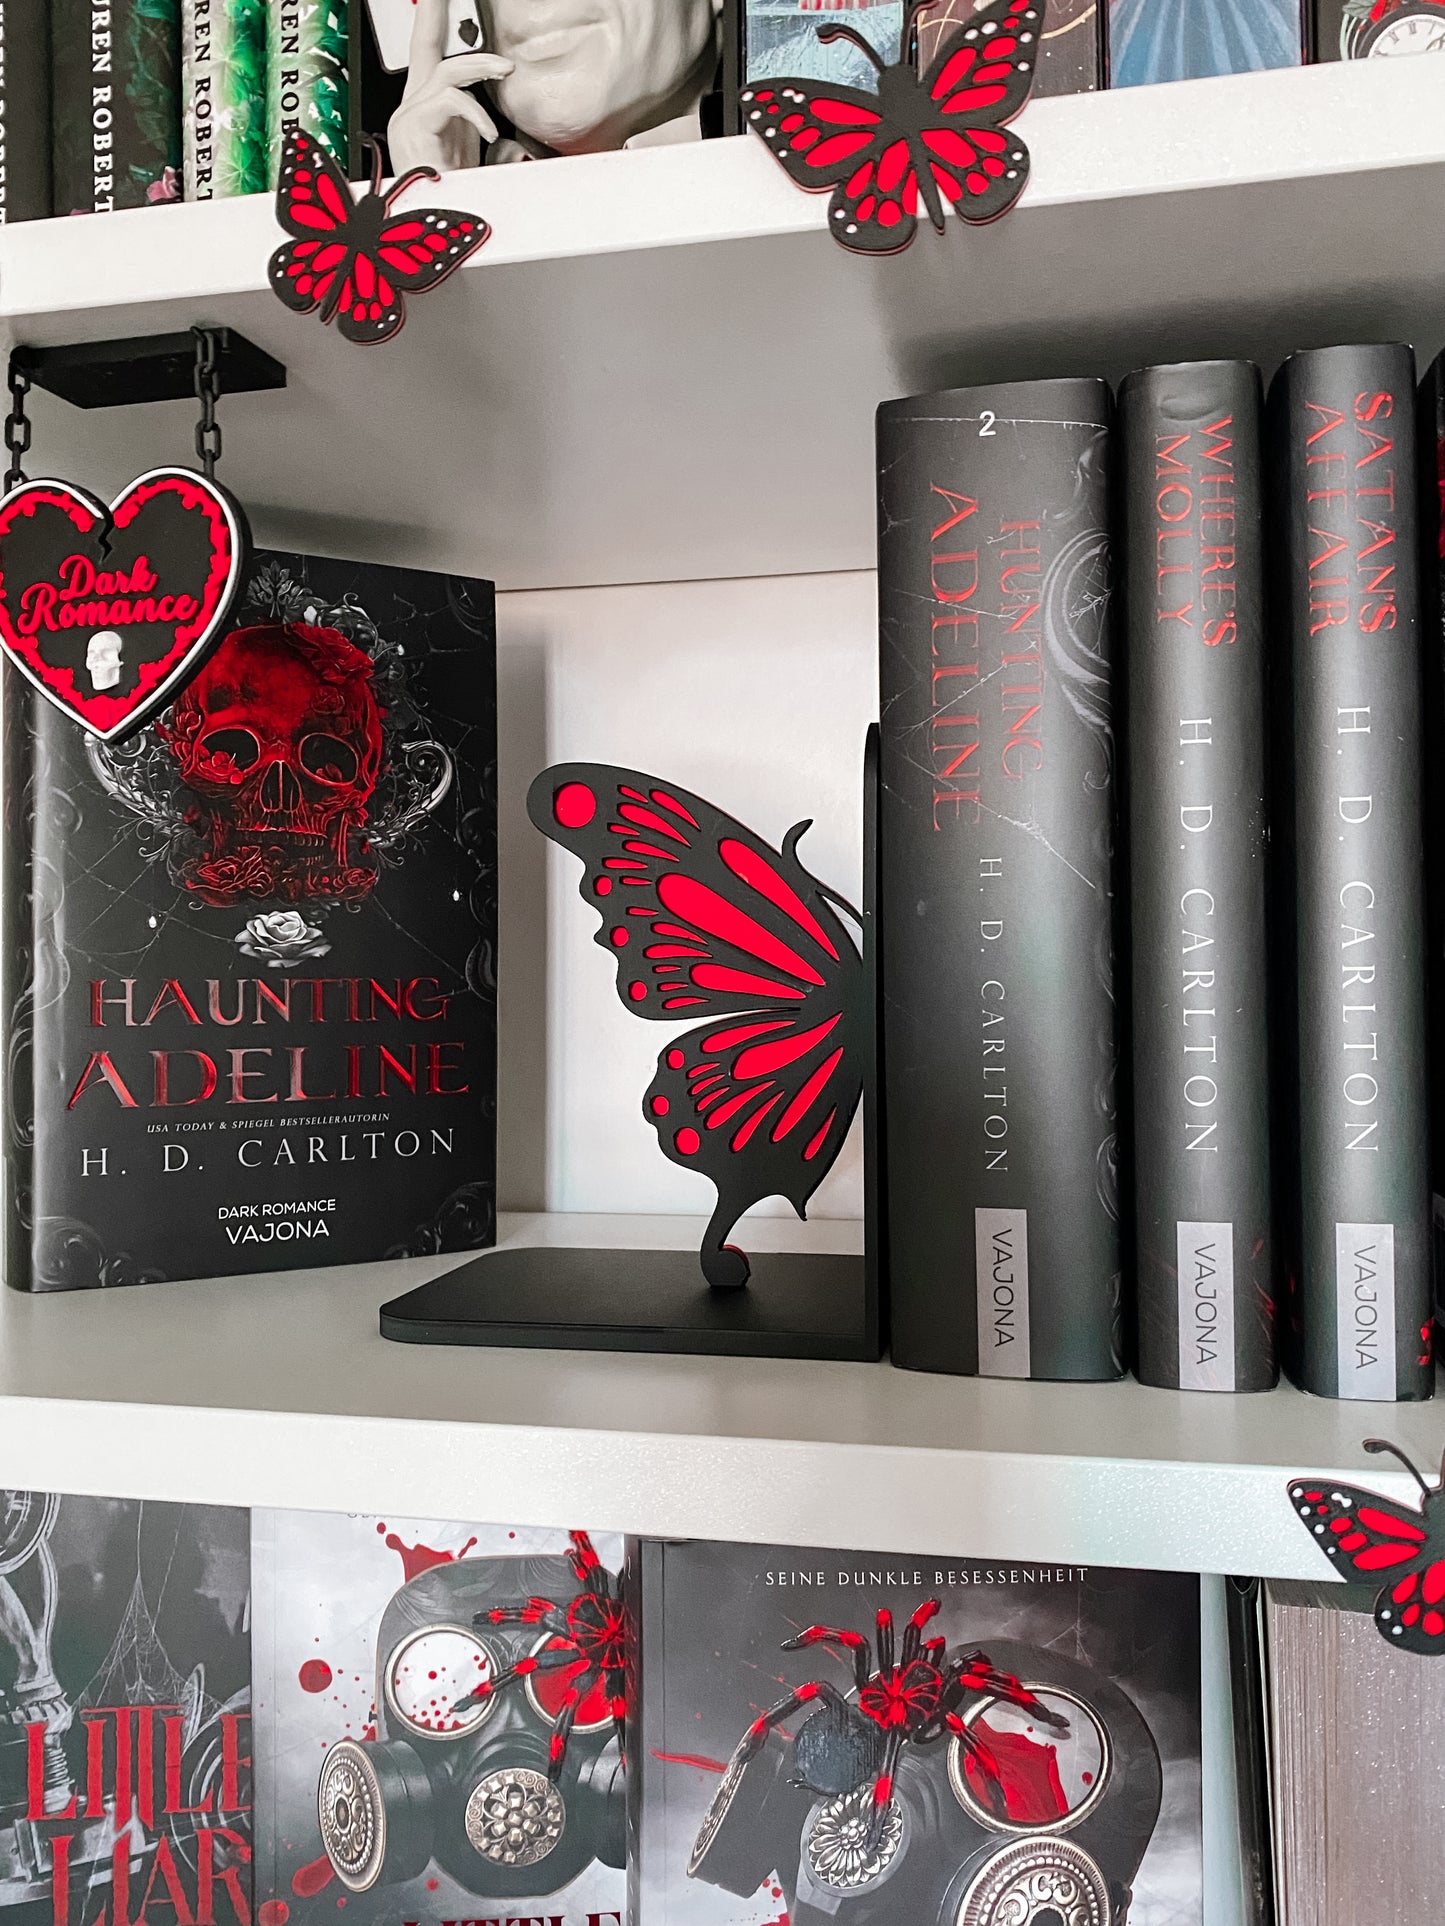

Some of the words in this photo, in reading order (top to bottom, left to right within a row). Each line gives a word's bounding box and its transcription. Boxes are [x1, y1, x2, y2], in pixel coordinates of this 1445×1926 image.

[91, 0, 112, 72] REN
[92, 85, 114, 213] ROBERT
[195, 76, 213, 200] ROBERT
[978, 411, 997, 437] 2
[1155, 433, 1194, 627] MOLLY
[1199, 414, 1237, 647] WHERE'S
[1305, 401, 1350, 637] AFFAIR
[1354, 391, 1398, 633] SATAN'S
[18, 582, 198, 635] Romance
[59, 554, 158, 601] Dark
[930, 481, 981, 832] ADELINE
[1000, 520, 1044, 782] HUNTING
[1179, 717, 1212, 766] H.
[1337, 705, 1371, 755] H.
[1180, 805, 1213, 850] D.
[1338, 795, 1373, 841] D.
[979, 857, 1002, 892] H.
[980, 919, 1004, 953] D.
[90, 976, 453, 1027] HAUNTING
[1180, 888, 1218, 1153] CARLTON
[1339, 881, 1379, 1152] CARLTON
[64, 1042, 470, 1110] ADELINE
[980, 980, 1008, 1172] CARLTON
[81, 1148, 127, 1176] H.
[163, 1144, 204, 1172] D.
[237, 1128, 454, 1168] CARLTON
[147, 1124, 169, 1133] USA
[175, 1122, 215, 1132] TODAY
[219, 1122, 227, 1130] &
[232, 1119, 275, 1129] SPIEGEL
[280, 1113, 391, 1127] BESTSELLERAUTORIN
[218, 1205, 259, 1220] DARK
[263, 1198, 336, 1217] ROMANCE
[225, 1219, 330, 1245] VAJONA
[992, 1228, 1015, 1348] VAJONA
[1194, 1243, 1218, 1365] VAJONA
[1353, 1245, 1378, 1369] VAJONA
[765, 1571, 826, 1586] SEINE
[838, 1571, 922, 1586] DUNKLE
[934, 1568, 1088, 1585] BESESSENHEIT
[24, 1705, 251, 1832] LITTLE
[49, 1829, 251, 1926] LIAR
